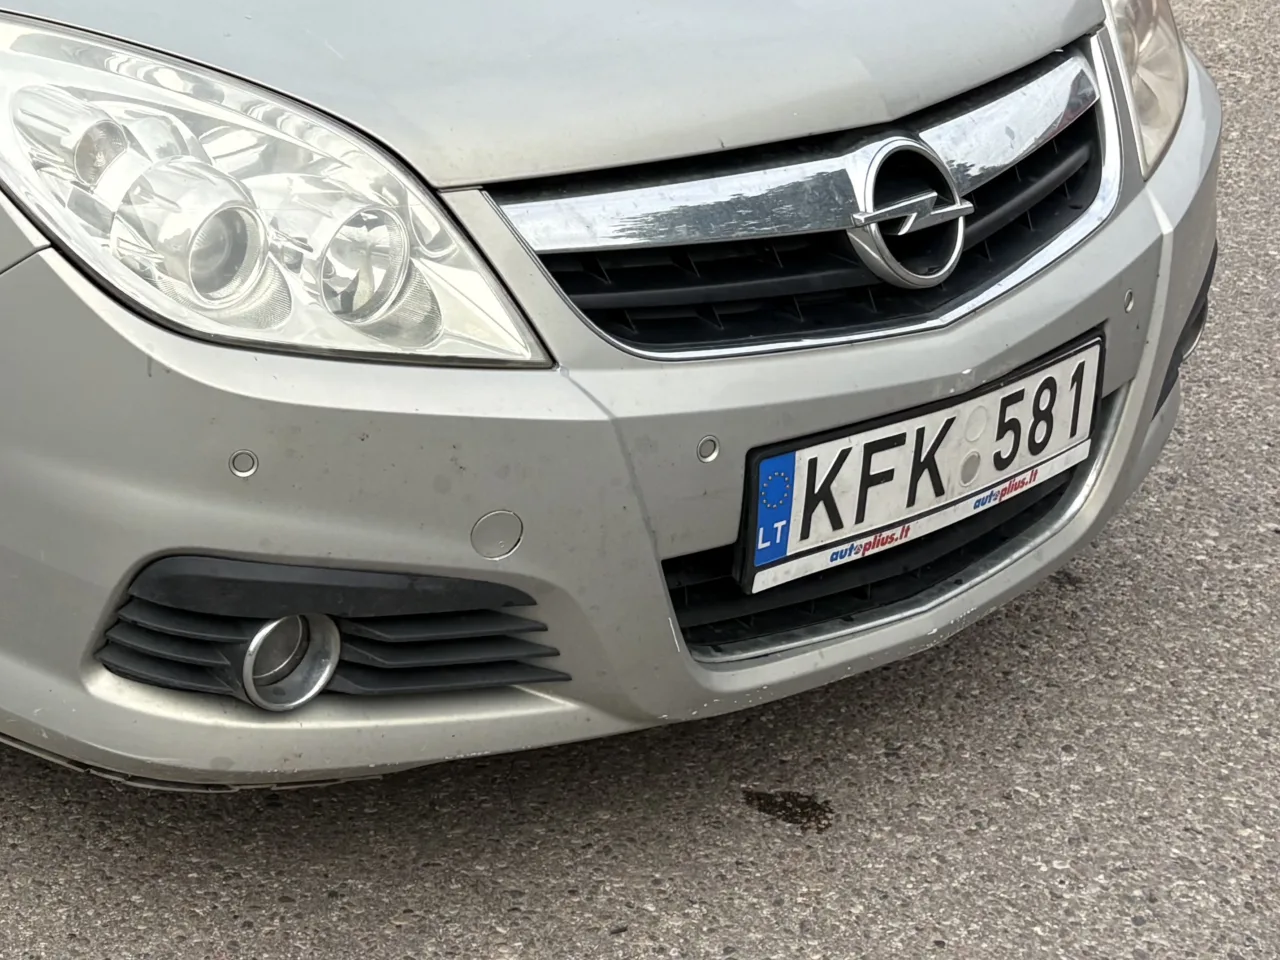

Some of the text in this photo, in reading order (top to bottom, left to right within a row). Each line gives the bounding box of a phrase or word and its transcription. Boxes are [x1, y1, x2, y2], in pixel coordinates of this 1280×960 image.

[799, 360, 1086, 541] KFK 581
[973, 469, 1038, 510] autoplius.lt
[758, 520, 787, 550] LT
[829, 525, 911, 562] autoplius.lt
